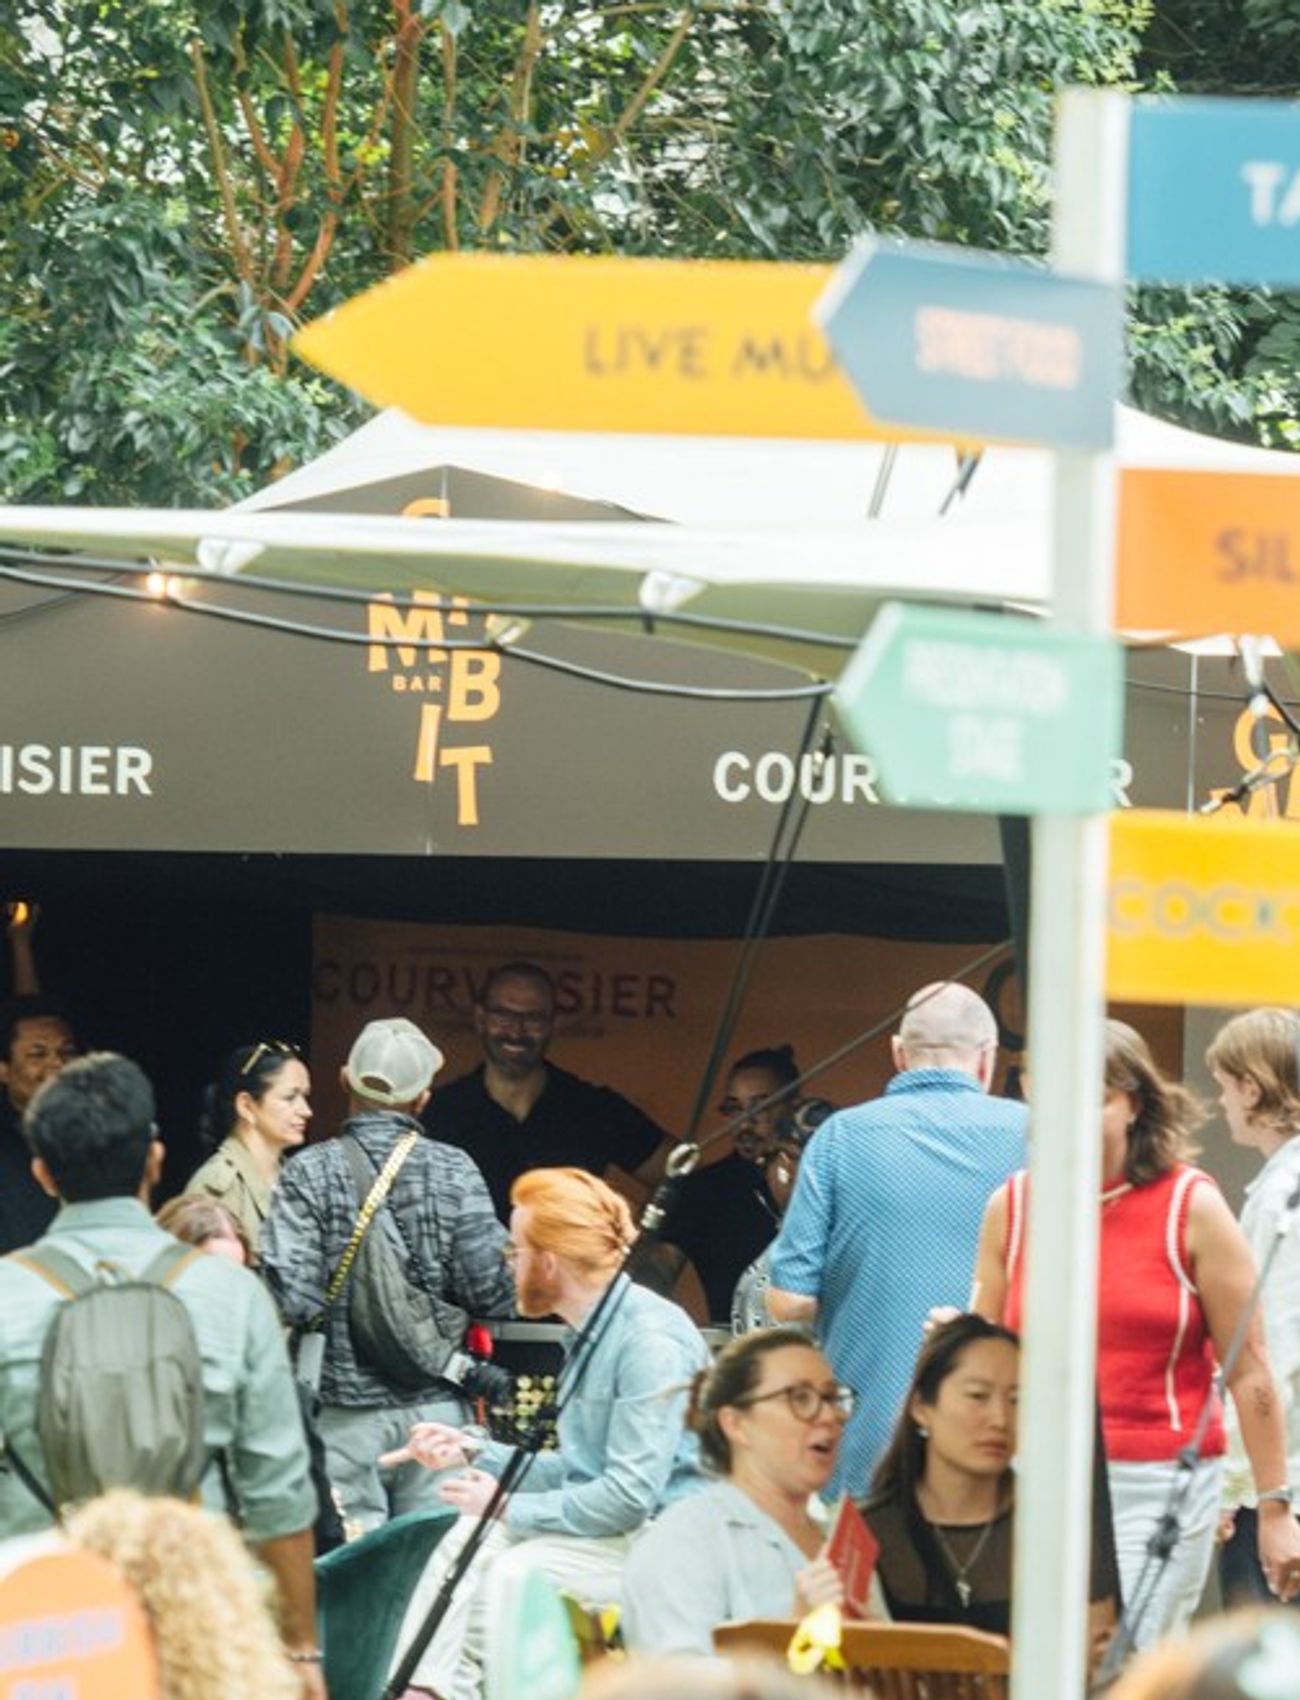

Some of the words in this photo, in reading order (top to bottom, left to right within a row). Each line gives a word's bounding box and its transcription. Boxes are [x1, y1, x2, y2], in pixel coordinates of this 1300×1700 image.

[585, 328, 708, 379] LIVE
[392, 675, 443, 692] BAR
[0, 746, 153, 796] ISIER
[313, 959, 677, 1018] COURVSIER
